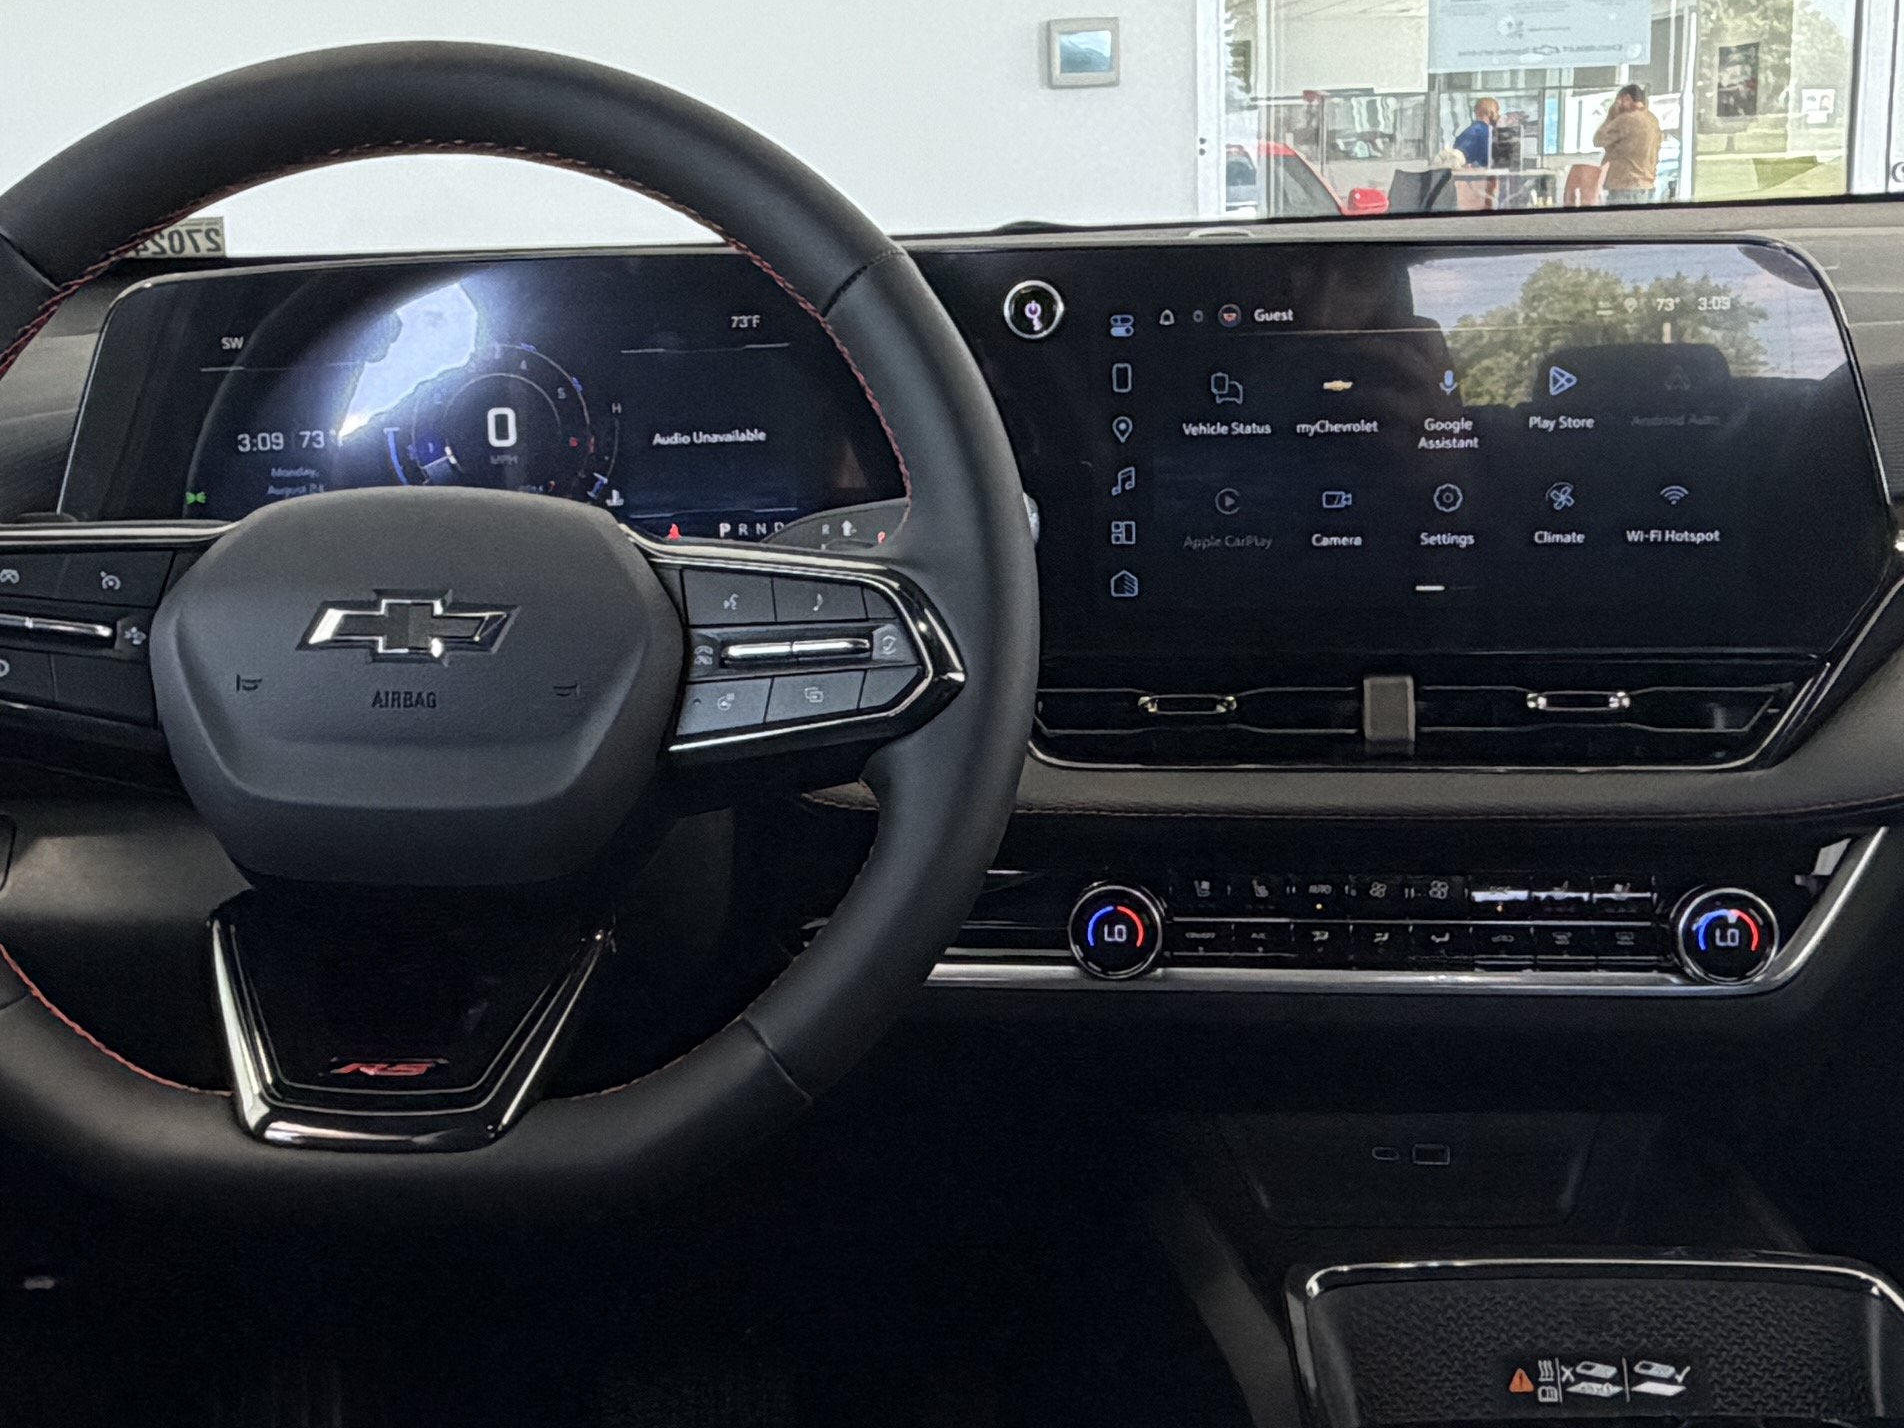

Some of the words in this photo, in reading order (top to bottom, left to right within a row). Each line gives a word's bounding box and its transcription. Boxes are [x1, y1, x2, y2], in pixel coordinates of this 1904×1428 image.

[1254, 308, 1294, 323] Guest
[221, 337, 244, 350] SW
[487, 407, 517, 448] 0
[1183, 422, 1229, 436] Vehicle
[1231, 421, 1272, 435] Status
[1296, 420, 1379, 437] myChevrolet
[1424, 417, 1474, 434] Google
[1528, 415, 1557, 432] Play
[1559, 415, 1595, 429] Store
[237, 432, 284, 452] 3:09
[653, 431, 691, 446] Audio
[693, 428, 767, 445] Unavailable
[1417, 435, 1479, 450] Assistant
[719, 523, 731, 537] P
[739, 523, 748, 535] R
[756, 523, 766, 535] N
[1533, 530, 1585, 544] Climate
[1626, 530, 1662, 543] Wi-Fi
[1664, 529, 1721, 545] Hotspot
[1183, 535, 1222, 552] Apple
[1224, 534, 1273, 551] CarPlay
[1311, 533, 1362, 547] Camera
[1419, 532, 1475, 548] Settings
[372, 691, 437, 709] AIRBAG
[1103, 924, 1127, 942] LO
[1715, 927, 1739, 947] LO
